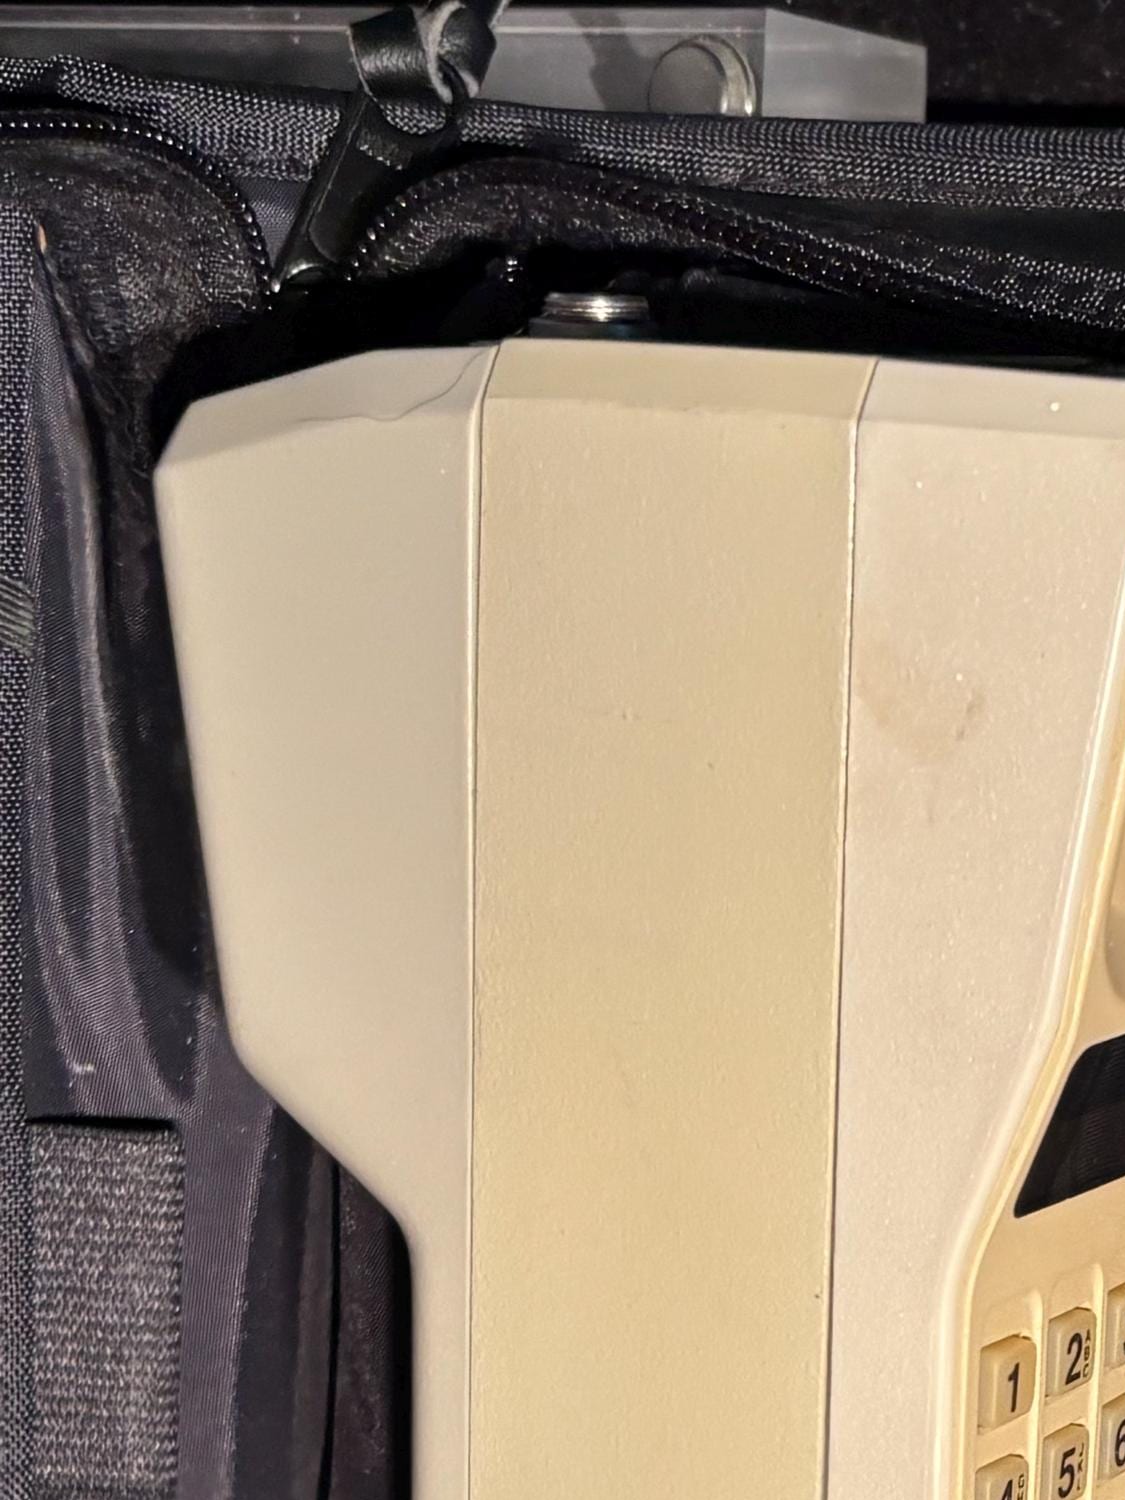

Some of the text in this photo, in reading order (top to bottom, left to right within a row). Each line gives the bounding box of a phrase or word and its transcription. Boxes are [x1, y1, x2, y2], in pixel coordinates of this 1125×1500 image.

[1065, 1332, 1083, 1386] 2
[1083, 1329, 1092, 1378] ABC
[1007, 1362, 1020, 1413] 1
[1058, 1447, 1077, 1498] 5
